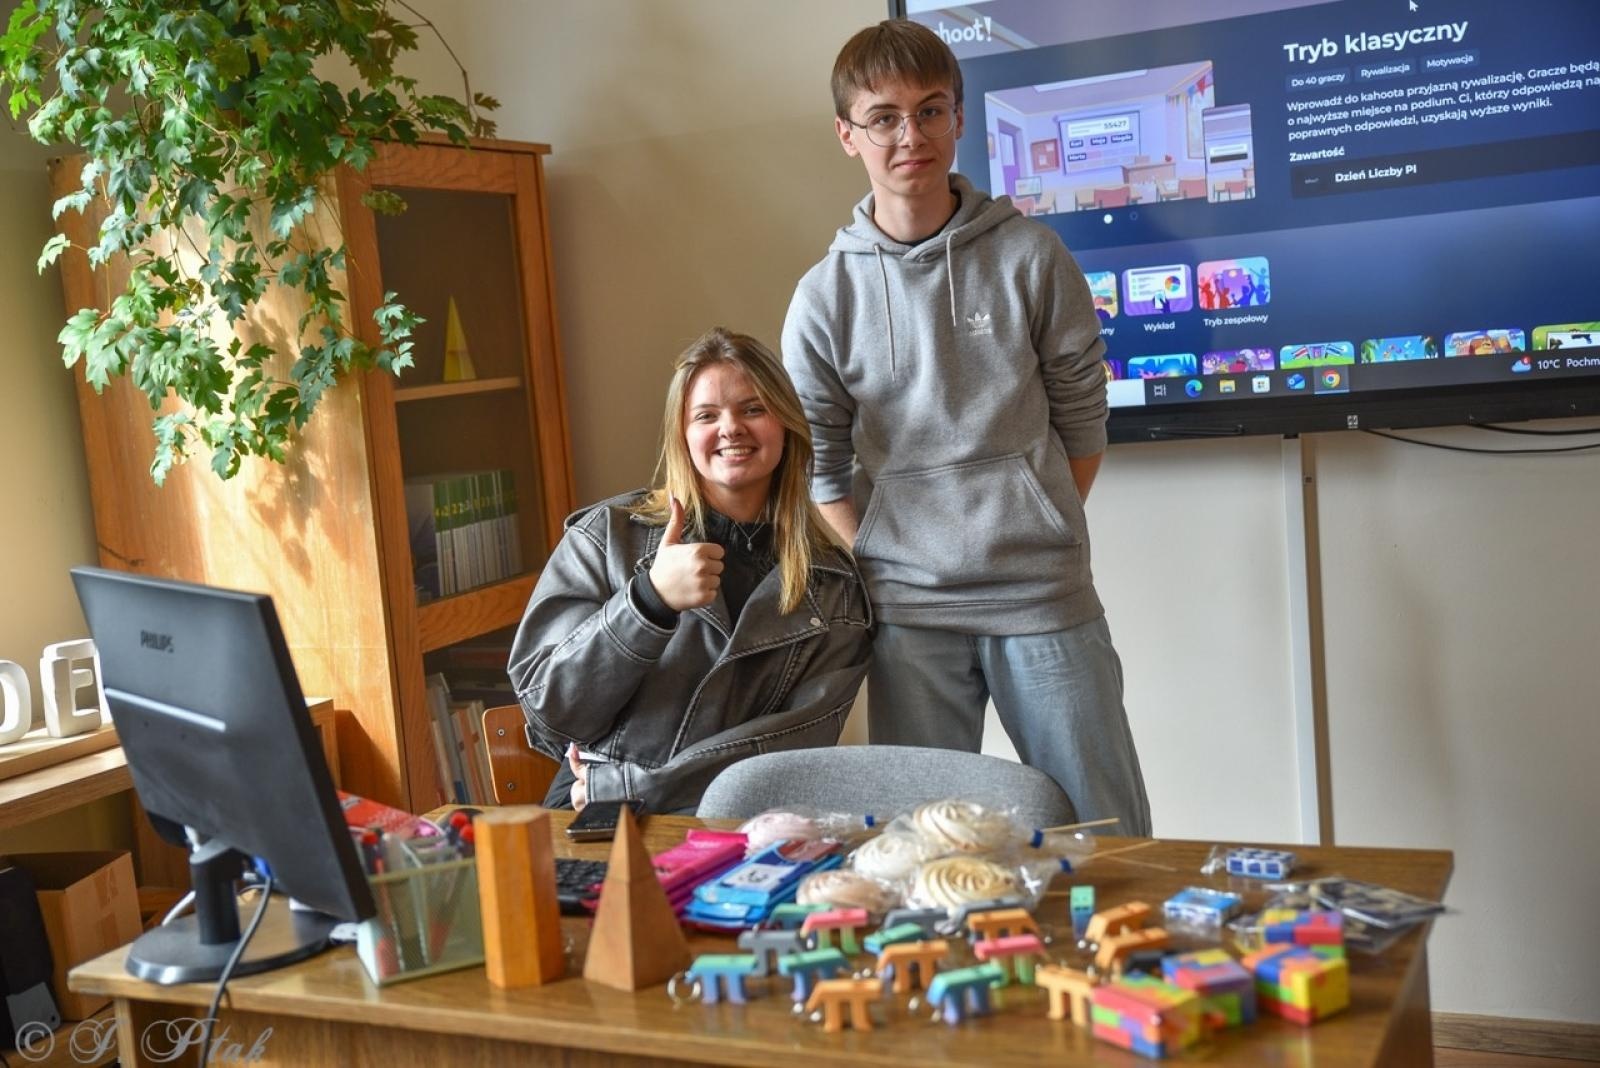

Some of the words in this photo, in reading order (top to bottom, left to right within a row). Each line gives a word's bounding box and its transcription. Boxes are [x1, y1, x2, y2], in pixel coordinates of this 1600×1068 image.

[934, 16, 992, 45] hoot!
[1283, 38, 1338, 64] Tryb
[1344, 21, 1469, 54] klasyczny
[1426, 54, 1475, 68] Motywacja
[1360, 63, 1411, 78] Rywalizacja
[1286, 96, 1343, 112] Wprowadź
[1344, 93, 1359, 105] do
[1361, 88, 1405, 102] kahoota
[1406, 81, 1458, 98] przyjazną
[1460, 70, 1526, 90] rywalizację.
[1527, 65, 1567, 79] Gracze
[1569, 60, 1600, 75] będą
[1291, 78, 1304, 87] Do
[1305, 76, 1317, 85] 40
[1318, 73, 1346, 86] graczy
[1296, 110, 1350, 126] najwyższe
[1351, 104, 1393, 118] miejsce
[1394, 102, 1409, 112] na
[1410, 97, 1456, 112] podium.
[1458, 92, 1473, 104] Ci,
[1474, 89, 1510, 102] którzy
[1511, 79, 1583, 97] odpowiedzą
[1287, 122, 1352, 142] poprawnych
[1354, 115, 1419, 133] odpowiedzi,
[1420, 108, 1468, 125] uzyskają
[1469, 103, 1511, 118] wyższe
[1511, 97, 1553, 112] wyniki.
[1289, 146, 1346, 163] Zawartość
[1334, 169, 1366, 183] Dzień
[1368, 166, 1403, 179] Liczby
[1203, 317, 1223, 328] Tryb
[1537, 358, 1561, 370] 10°C
[140, 629, 175, 654] PHILIPS
